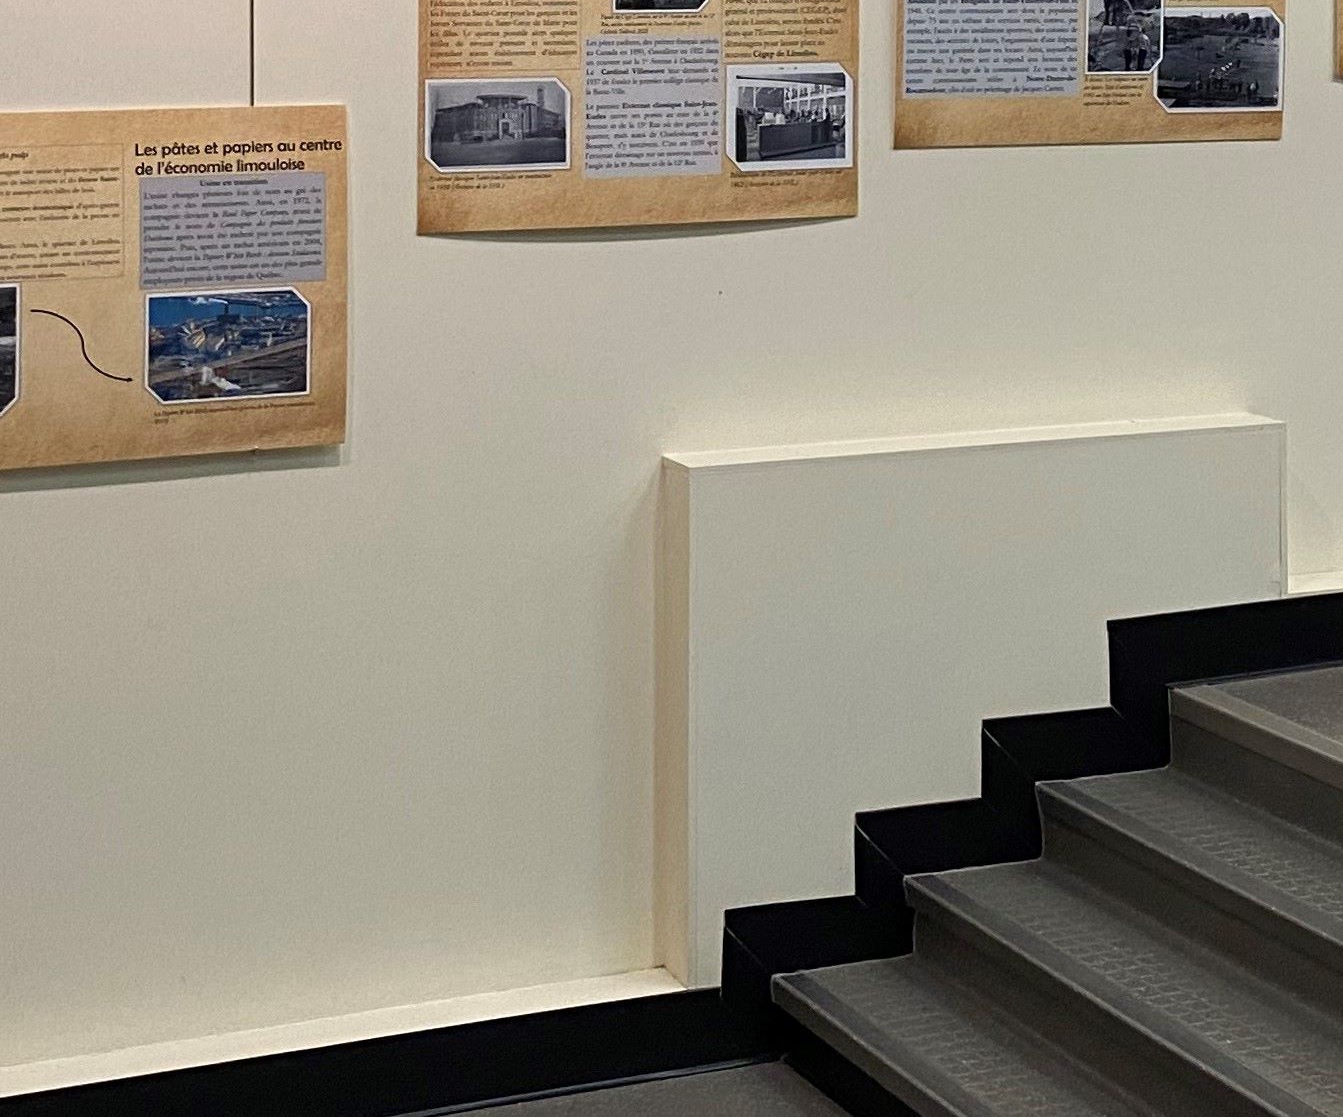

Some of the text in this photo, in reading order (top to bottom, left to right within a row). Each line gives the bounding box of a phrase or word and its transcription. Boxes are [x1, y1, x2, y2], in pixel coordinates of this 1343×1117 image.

[135, 139, 342, 158] Les pâtes et papiers au centre
[135, 157, 304, 175] de l'économie limouloise
